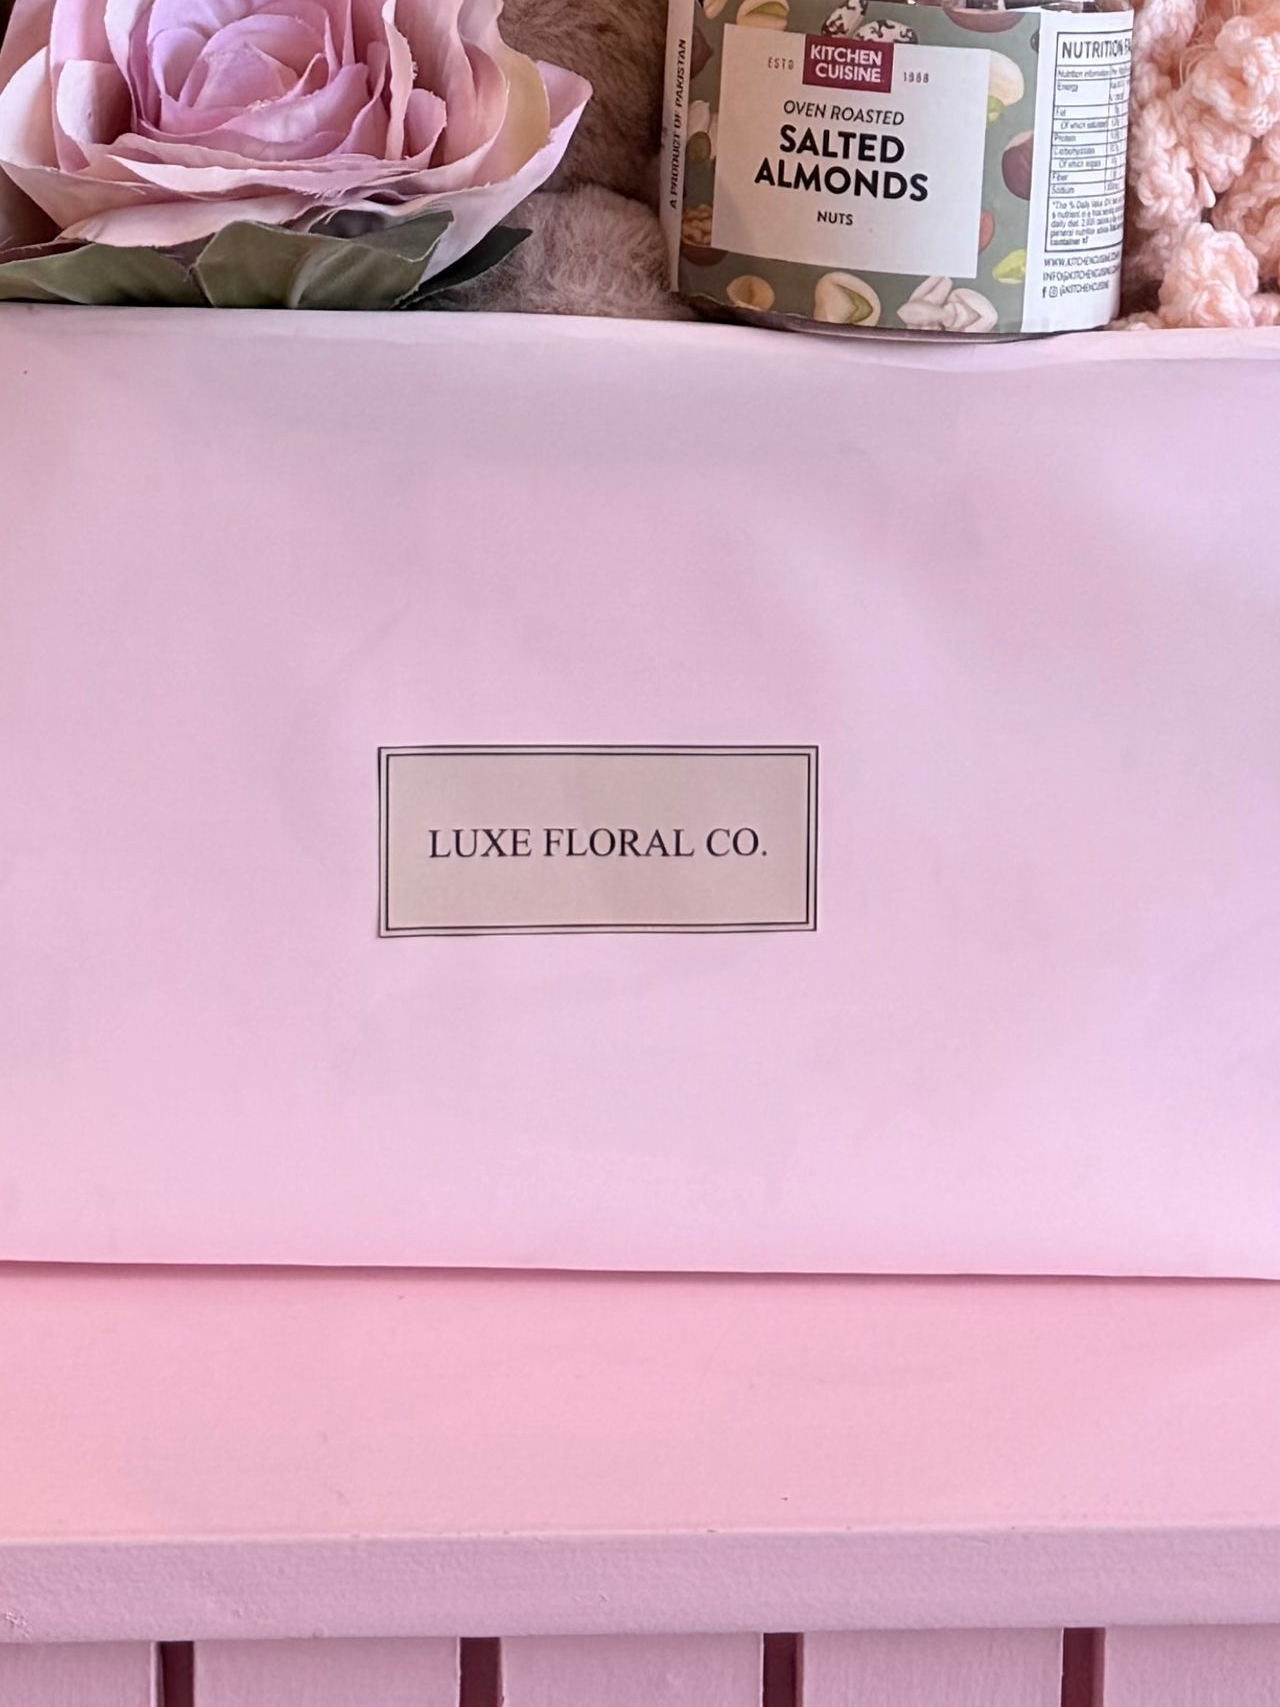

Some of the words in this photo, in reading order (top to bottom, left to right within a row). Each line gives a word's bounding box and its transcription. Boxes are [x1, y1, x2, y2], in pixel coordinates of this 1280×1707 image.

[810, 44, 882, 66] KITCHEN
[1061, 39, 1123, 59] NUTRITION
[675, 39, 687, 108] PAKISTAN
[815, 63, 881, 83] CUISINE
[783, 100, 827, 119] OVEN
[830, 105, 905, 126] ROASTED
[779, 124, 905, 164] SALTED
[754, 157, 929, 202] ALMONDS
[817, 211, 853, 226] NUTS
[428, 830, 532, 858] LUXE
[543, 828, 695, 857] FLORAL
[706, 827, 768, 857] CO.
